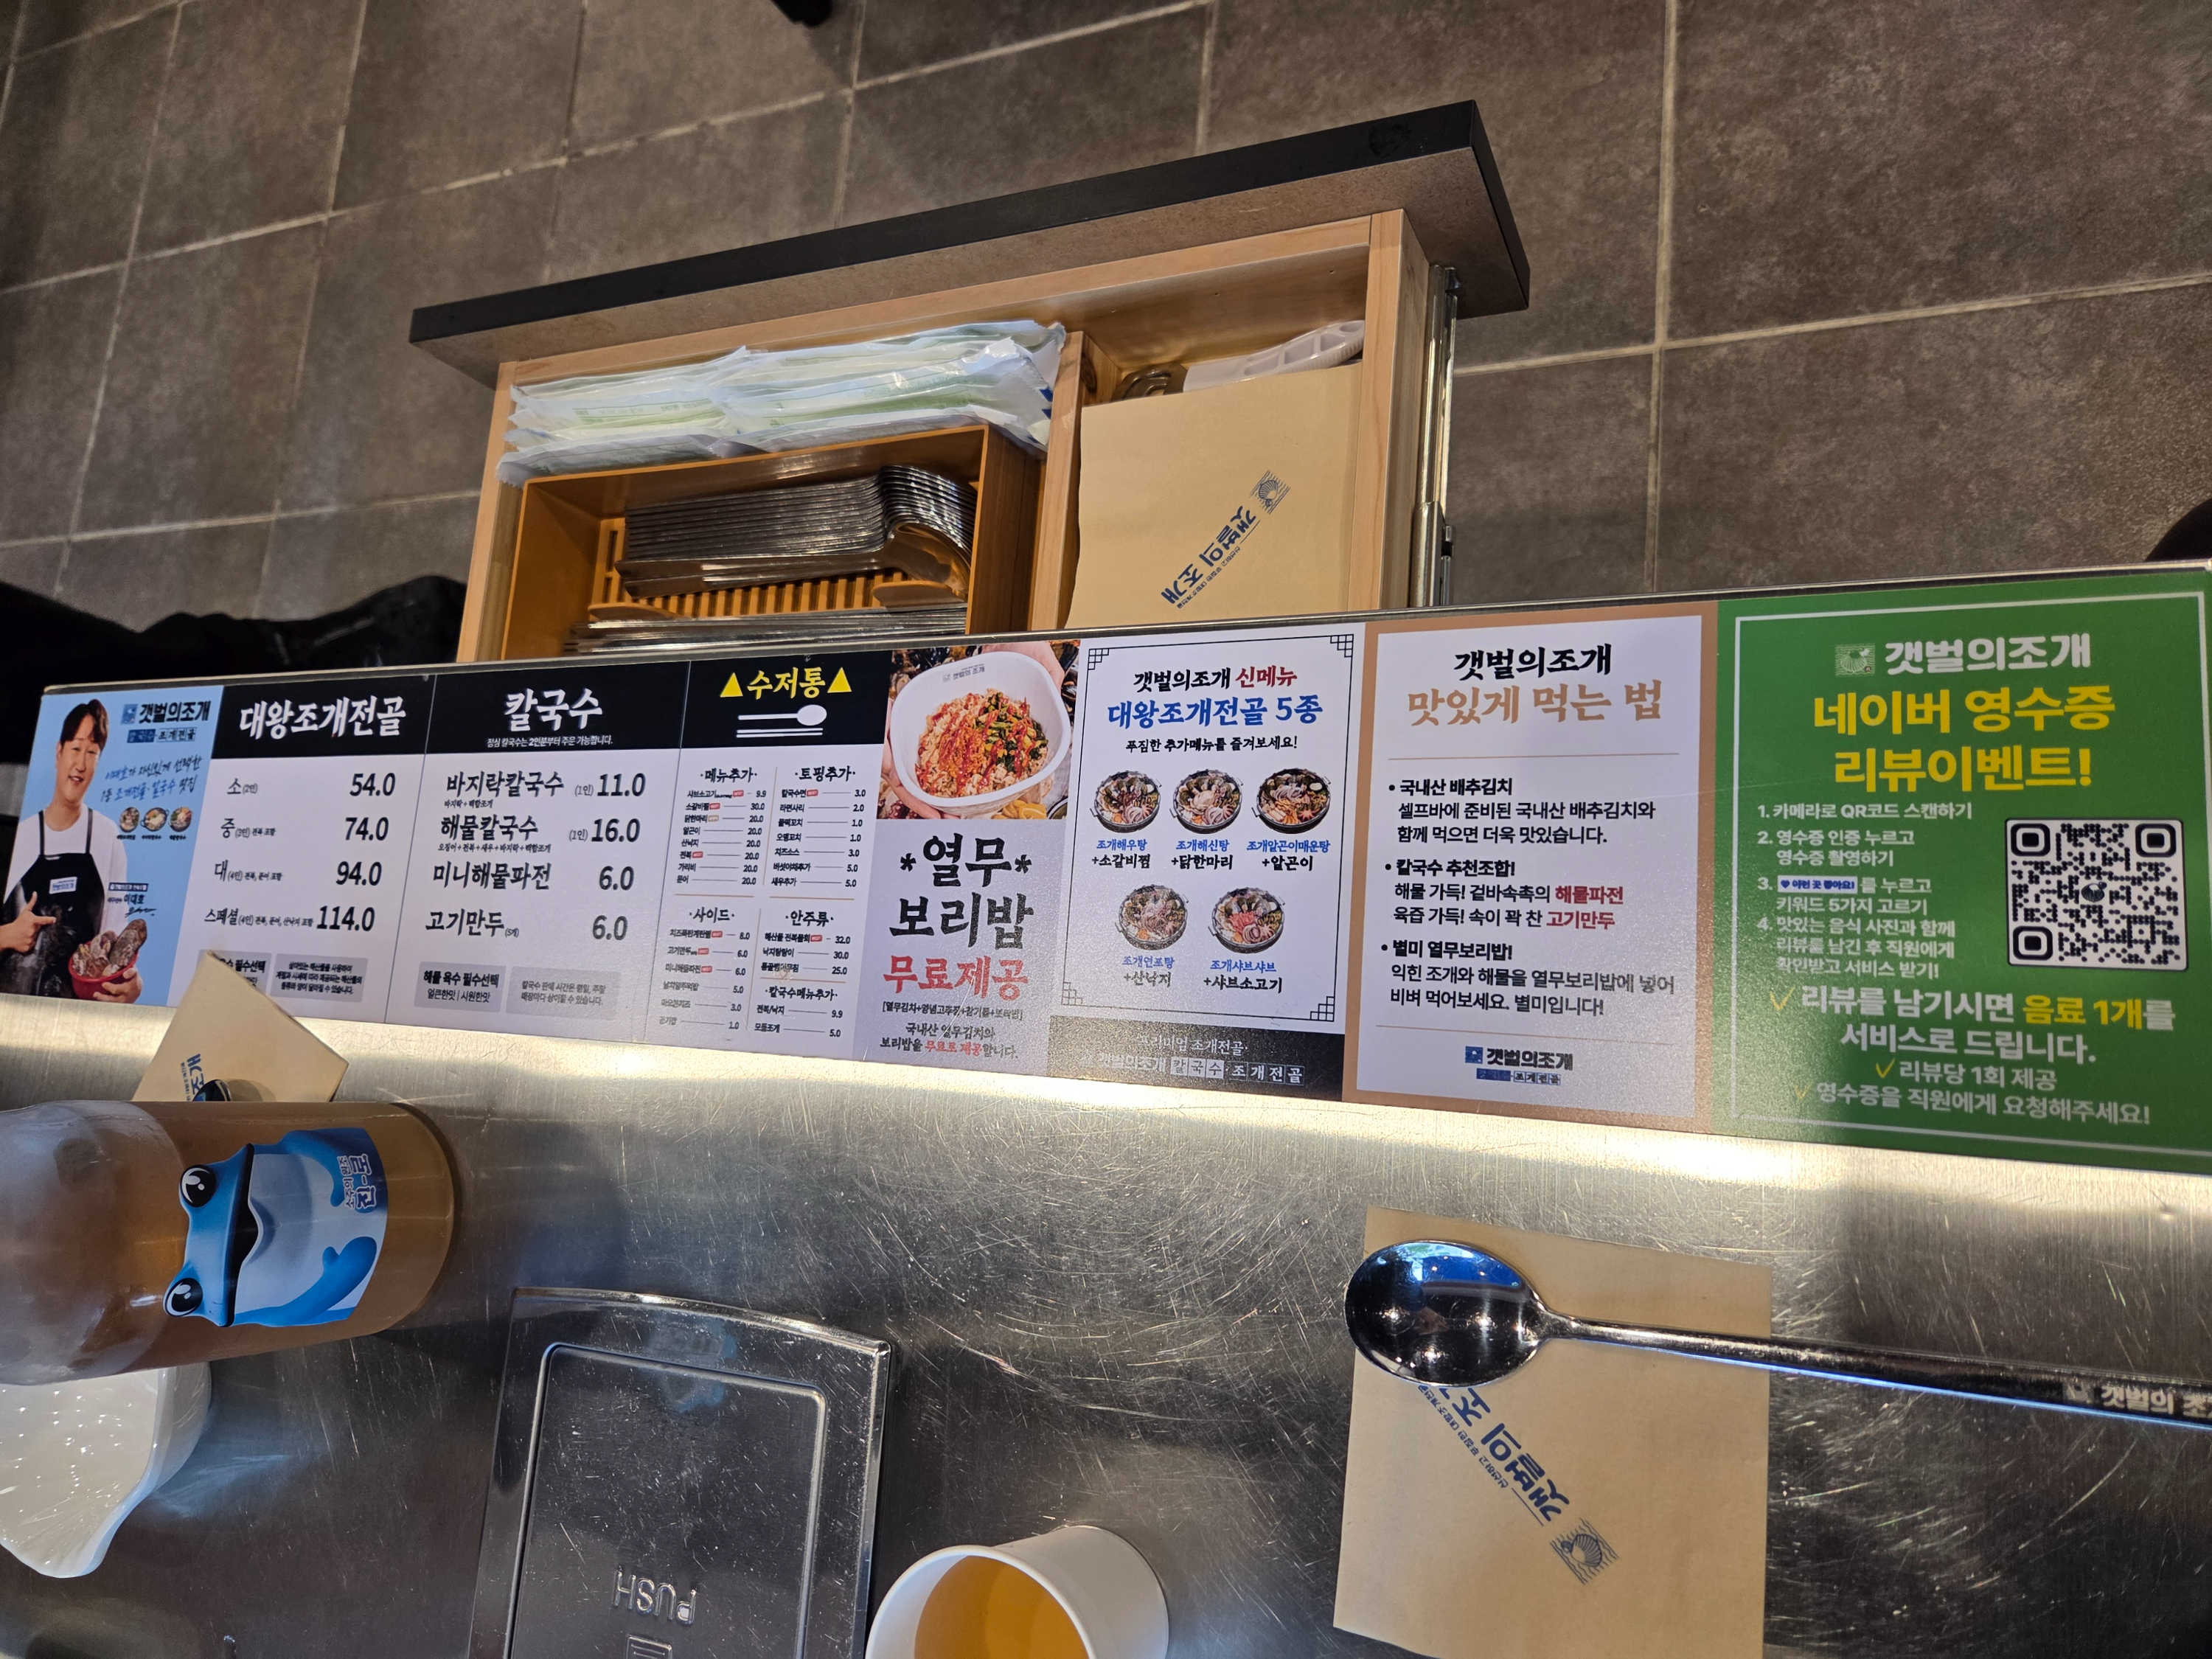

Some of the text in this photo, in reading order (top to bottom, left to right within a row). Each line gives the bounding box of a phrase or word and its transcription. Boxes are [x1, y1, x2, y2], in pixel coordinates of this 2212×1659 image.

[1161, 506, 1256, 604] 갯벌의 조개
[1453, 643, 1613, 681] 갯벌의조개
[1884, 633, 2092, 675] 갯벌의조개
[747, 667, 826, 700] 수저통
[1133, 665, 1298, 692] 갯벌의조개 신메뉴
[139, 700, 212, 723] 갯벌의조개
[504, 687, 603, 732] 칼국수
[1107, 694, 1324, 729] 대왕조개전골 5종
[1408, 679, 1663, 726] 맛있게 먹는 법
[1814, 686, 2115, 736] 네이버 영수증
[239, 695, 407, 740] 대왕조개전골
[1125, 736, 1298, 753] 푸짐한 추가메뉴를 즐겨보세요!
[1835, 744, 2092, 793] 리뷰이벤트!
[349, 773, 396, 797] 54.0
[446, 771, 564, 798] 바지락칼국수
[574, 773, 646, 797] (1인) 11.0
[756, 790, 767, 798] 9.9
[855, 789, 866, 797] 3.0
[1399, 778, 1513, 796] 국내산 배추김치
[751, 802, 765, 810] 30.0
[852, 804, 865, 812] 2.0
[1398, 801, 1656, 820] 셀프바에 준비된 국내산 배추김치와
[1773, 801, 1972, 820] 카메라로 QR코드 스캔하기
[344, 817, 389, 841] 74.0
[441, 814, 539, 841] 해물칼국수
[568, 818, 641, 842] (1인) 16.0
[851, 818, 863, 827] 1.0
[1096, 839, 1147, 852] 조개해우탕
[1175, 839, 1230, 852] 조개해신탕
[1246, 839, 1331, 853] 조개알곤이매운탕
[1397, 826, 1607, 844] 함께 먹으면 더욱 맛있습니다.
[1776, 830, 1915, 846] 영수증 인증 누르고
[848, 849, 860, 858] 3.0
[923, 832, 1012, 888] 열무
[1776, 849, 1893, 867] 영수증 촬영하기
[335, 861, 382, 886] 94.0
[433, 861, 552, 890] 미니해물파전
[599, 866, 635, 891] 6.0
[743, 864, 758, 873] 20.0
[1396, 859, 1515, 877] 칼국수 추천조합!
[741, 877, 757, 886] 20.0
[1861, 877, 1877, 894] 를
[1880, 877, 1932, 894] 누르고
[1394, 883, 1624, 905] 해물 가득! 겉바속촉의 해물파전
[1775, 897, 1928, 916] 키워드 5가지 고르기
[316, 905, 375, 932] 114.0
[592, 915, 628, 941] 6.0
[889, 892, 1034, 950] 보리밥
[1394, 907, 1615, 930] 육즙 가득! 속이 꽉 찬 고기만두
[1776, 917, 1955, 938] 맛있는 음식 사진과 함께
[835, 936, 851, 944] 32.0
[1393, 940, 1513, 960] 별미 열무보리밥!
[1775, 936, 1955, 959] 리뷰를 남긴 후 직원에게
[737, 950, 748, 958] 6.0
[833, 951, 849, 959] 30.0
[735, 967, 746, 975] 6.0
[832, 966, 847, 975] 25.0
[1210, 959, 1277, 973] 조개샤브샤브
[1843, 960, 1896, 978] 서비스
[1899, 961, 1939, 980] 받기!
[443, 971, 500, 989] 육수 필수선택
[883, 955, 1029, 1001] 무료제공
[1391, 964, 1675, 995] 익힌 조개와 해물을 열무보리밥에 넣어
[831, 1009, 843, 1018] 9.9
[1391, 989, 1604, 1016] 비벼 먹어보세요. 별미입니다!
[1801, 984, 2176, 1032] 리뷰를 남기시면 음료 1개를
[829, 1029, 841, 1037] 5.0
[880, 1037, 923, 1052] 보리밥을
[1840, 1023, 2097, 1065] 서비스로 드립니다.
[1486, 1047, 1573, 1071] 갯벌의조개
[1899, 1060, 2057, 1091] 리뷰당 1회 제공
[1816, 1081, 2151, 1126] 영수증을 직원에게 요청해주세요!
[337, 1155, 355, 1209] 소주의 원조
[2183, 1392, 2212, 1419] 조
[1439, 1387, 1571, 1522] 갯벌의 조
[612, 1571, 697, 1625] PUSH
